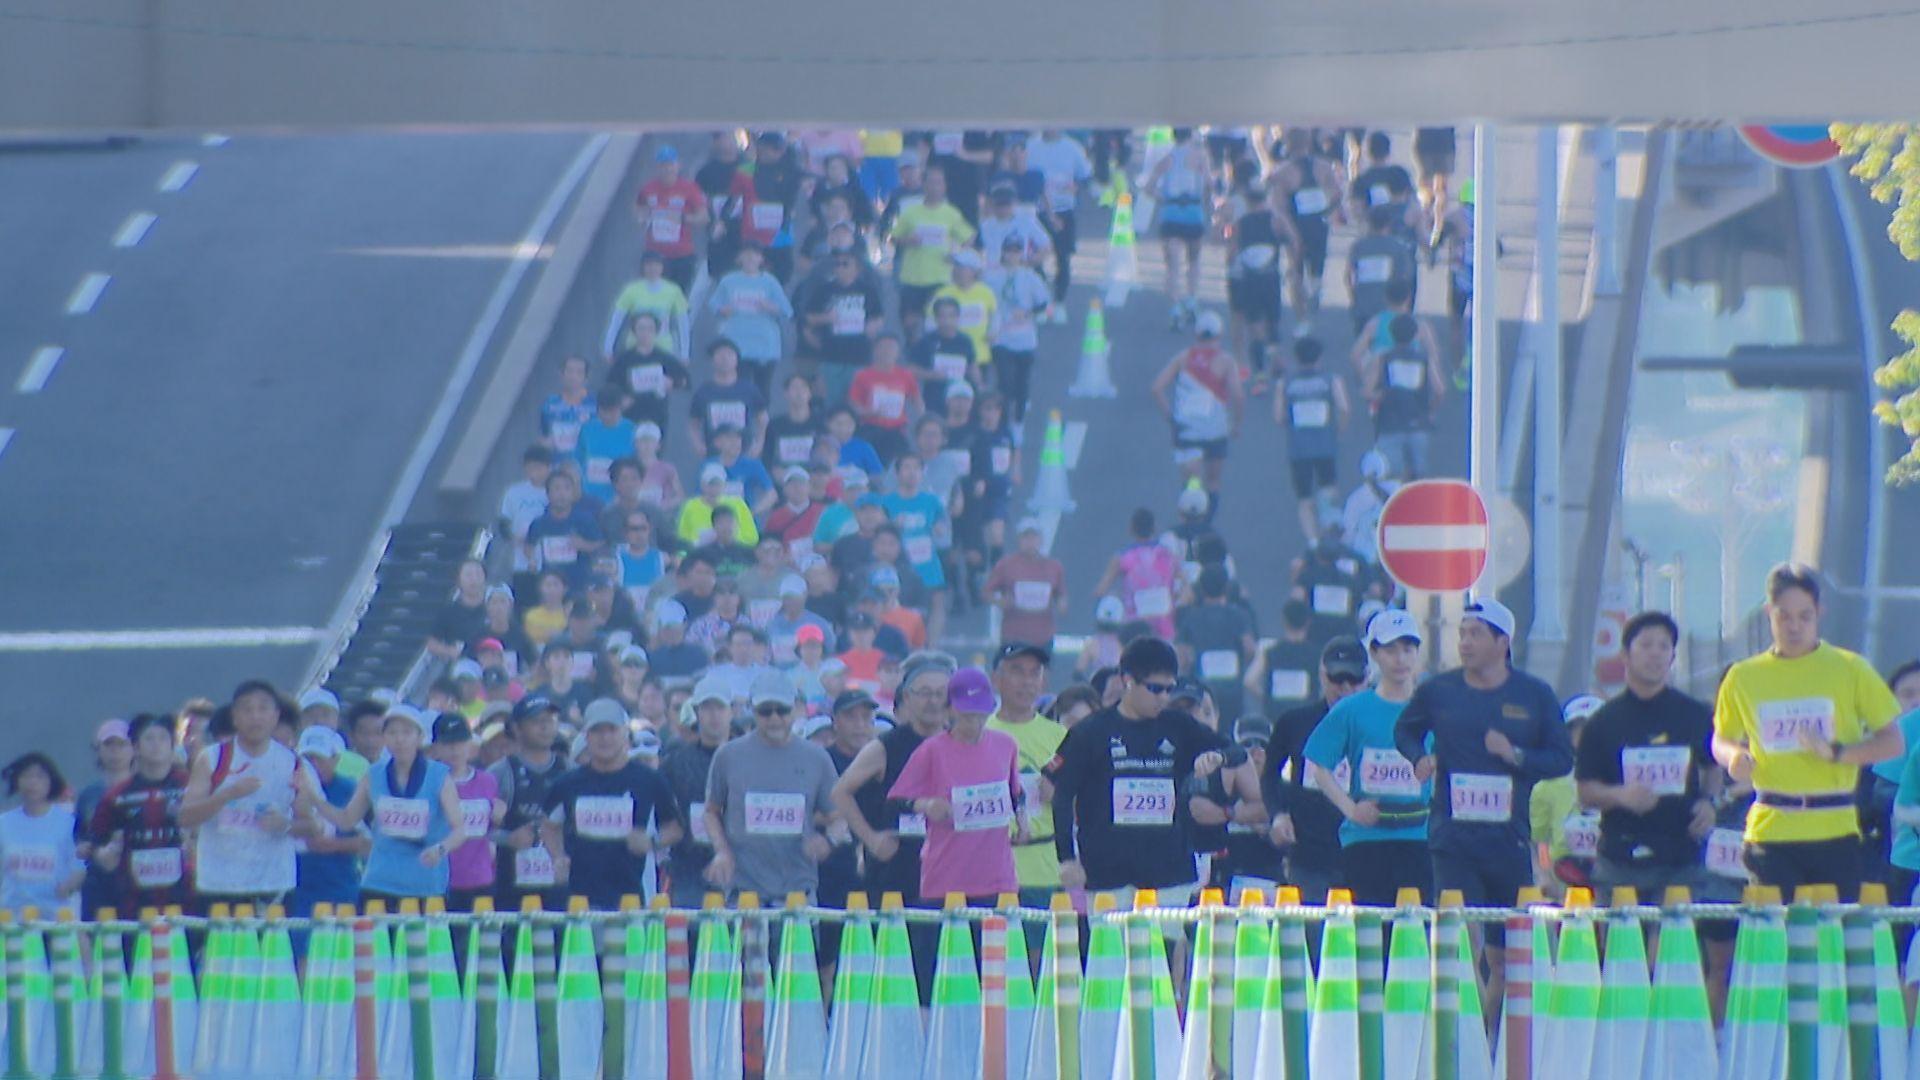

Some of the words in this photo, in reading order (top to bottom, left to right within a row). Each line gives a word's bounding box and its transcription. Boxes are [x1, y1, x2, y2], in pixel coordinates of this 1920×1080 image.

[1369, 764, 1411, 780] 2906
[1124, 795, 1167, 810] 2293
[1456, 791, 1498, 807] 3141
[755, 807, 795, 822] 2748
[964, 798, 1004, 817] 2431
[384, 811, 420, 826] 2720
